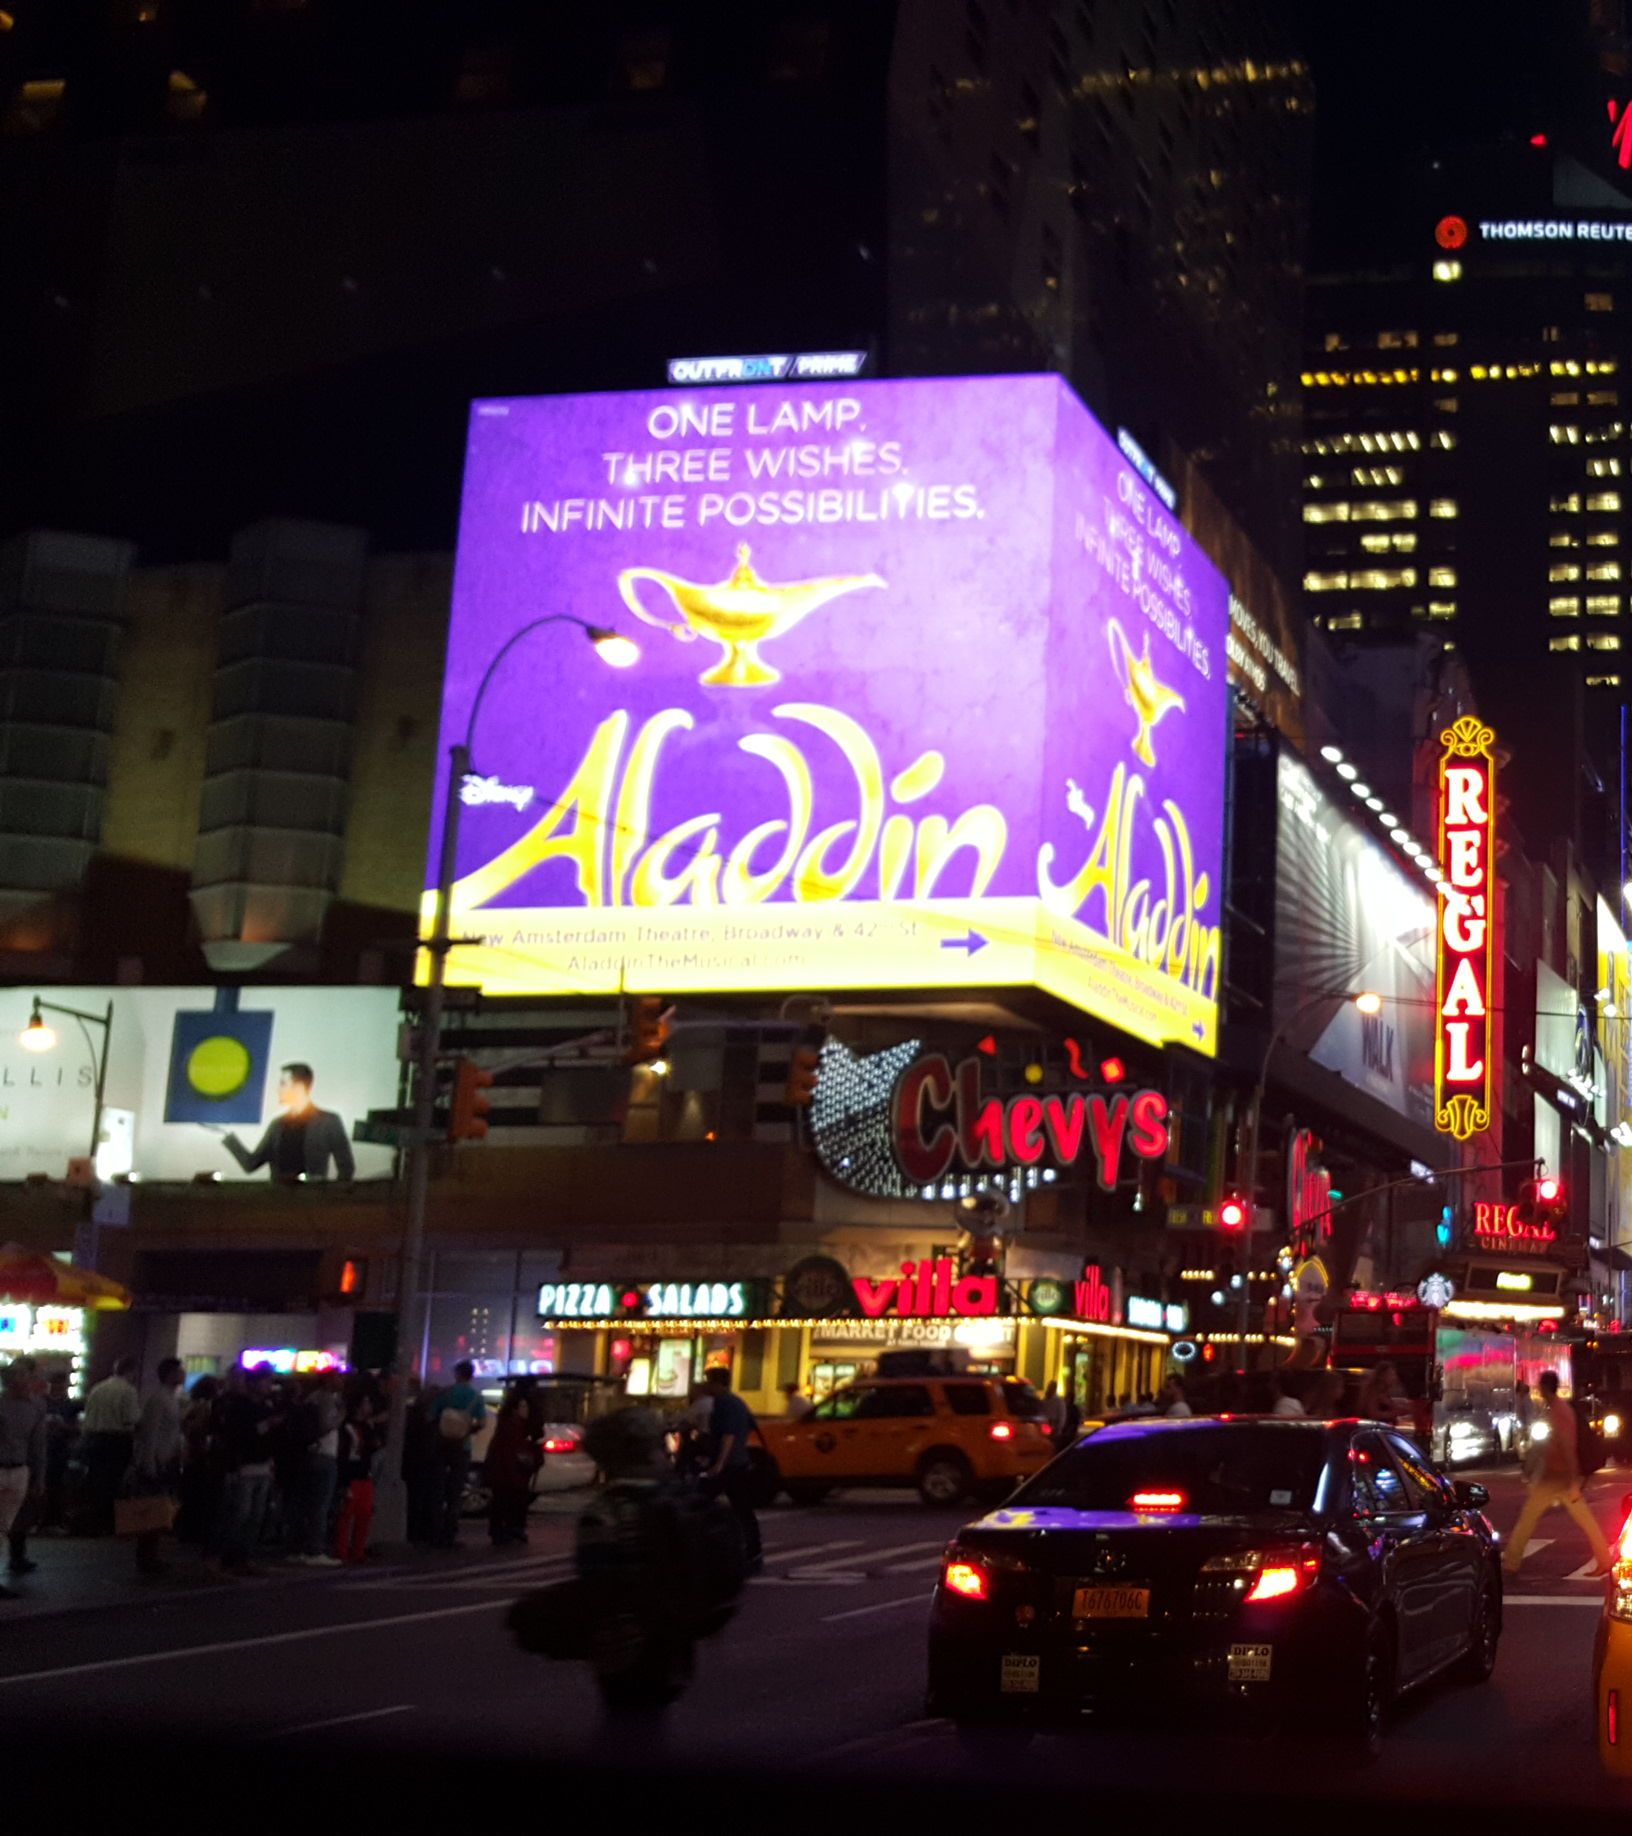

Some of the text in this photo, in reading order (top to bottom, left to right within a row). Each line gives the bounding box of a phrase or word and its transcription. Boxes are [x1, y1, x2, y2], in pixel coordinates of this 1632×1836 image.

[1480, 221, 1572, 240] THOMSON
[673, 353, 858, 381] OUTFRONT PRIME
[648, 397, 867, 440] ONE LAMP.
[602, 441, 909, 486] THREE WISHES.
[521, 484, 985, 534] INFINITE POSSIBILITIES.
[451, 702, 1008, 909] Aladdin
[460, 773, 535, 812] Disney
[1037, 761, 1221, 1003] Aladdin
[512, 928, 626, 945] Amsterdam
[724, 921, 824, 941] Broadway
[1441, 767, 1488, 1082] REGAL
[893, 1054, 1168, 1190] Chevys
[539, 1283, 745, 1316] PIZZA SALADS
[852, 1258, 998, 1317] villa
[902, 1323, 951, 1340] FOOD
